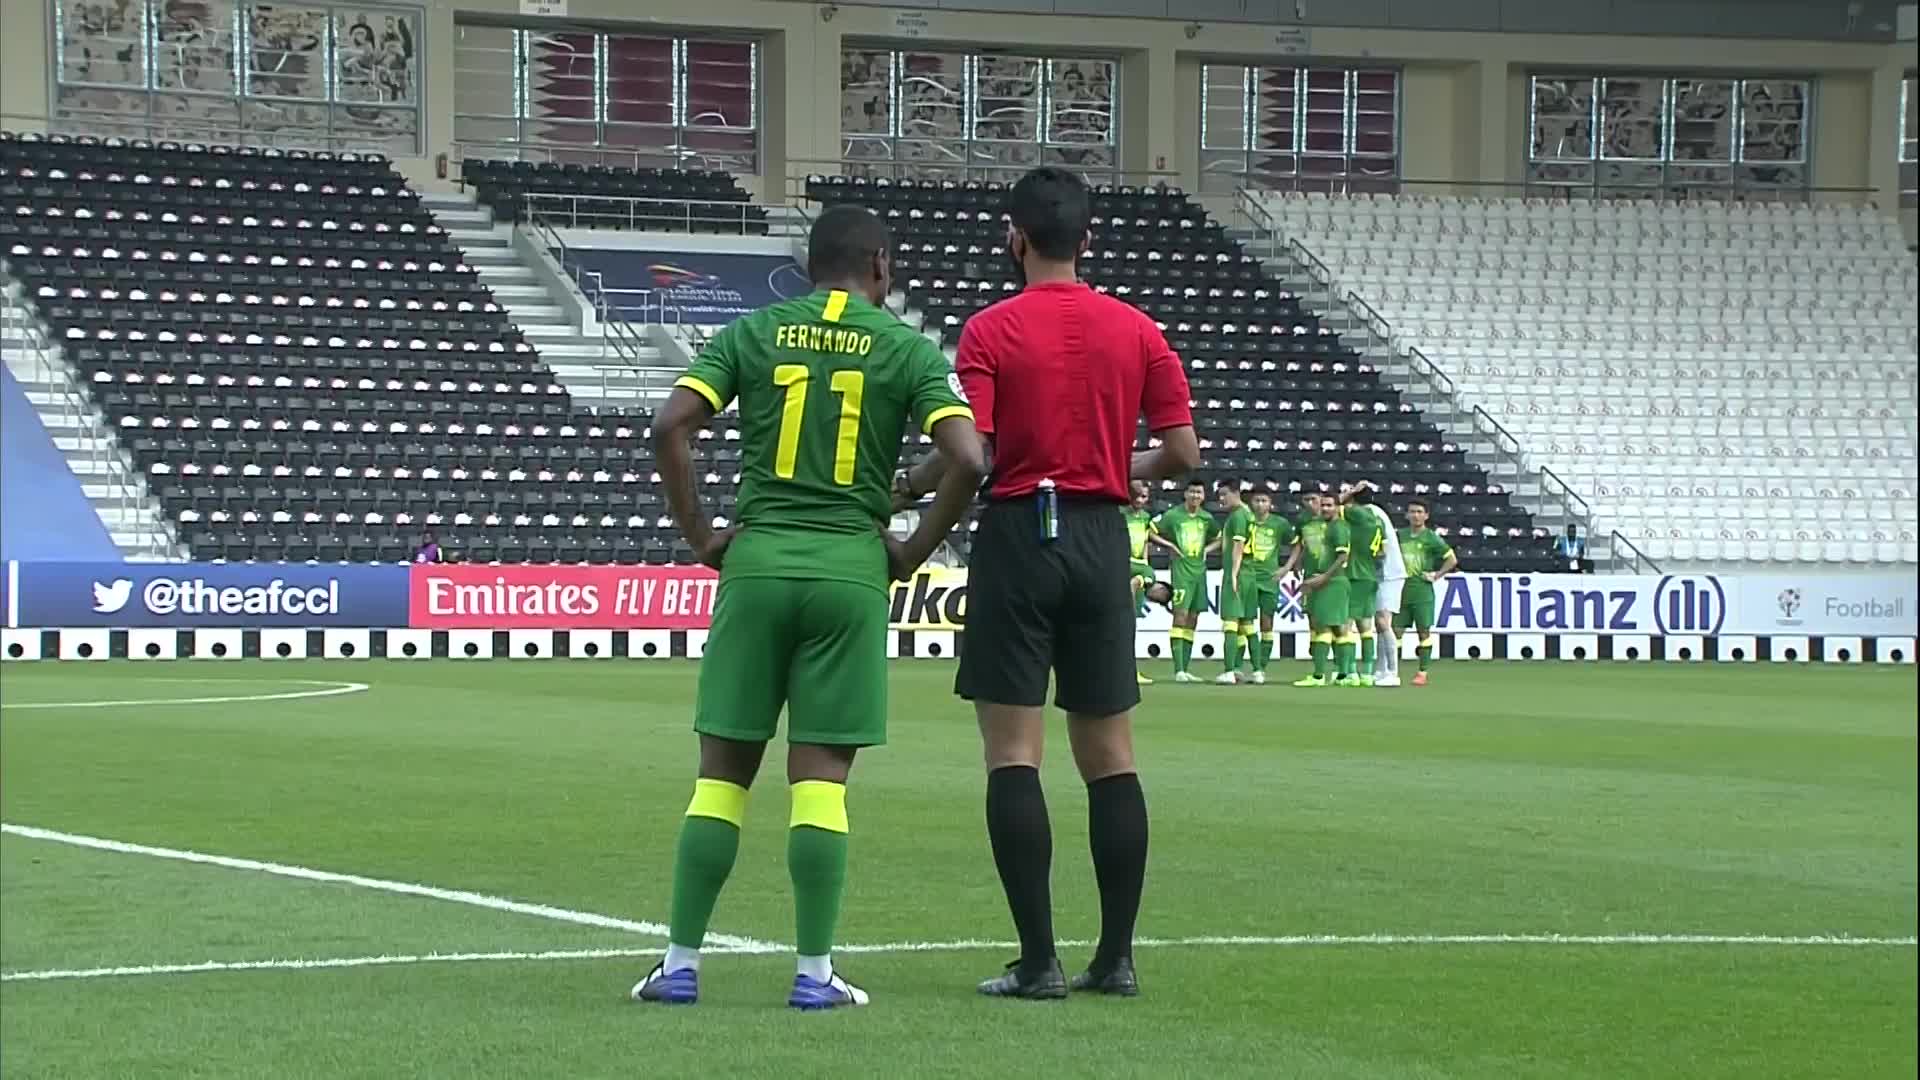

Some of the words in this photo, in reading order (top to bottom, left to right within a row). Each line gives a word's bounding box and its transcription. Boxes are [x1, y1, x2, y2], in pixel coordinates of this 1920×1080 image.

[776, 325, 871, 355] FERNANDO
[774, 364, 864, 485] 11
[144, 578, 339, 614] @theafccl
[427, 577, 599, 615] Emirates
[614, 579, 656, 615] FLY
[1436, 576, 1637, 630] Allianz
[1825, 597, 1904, 617] Football
